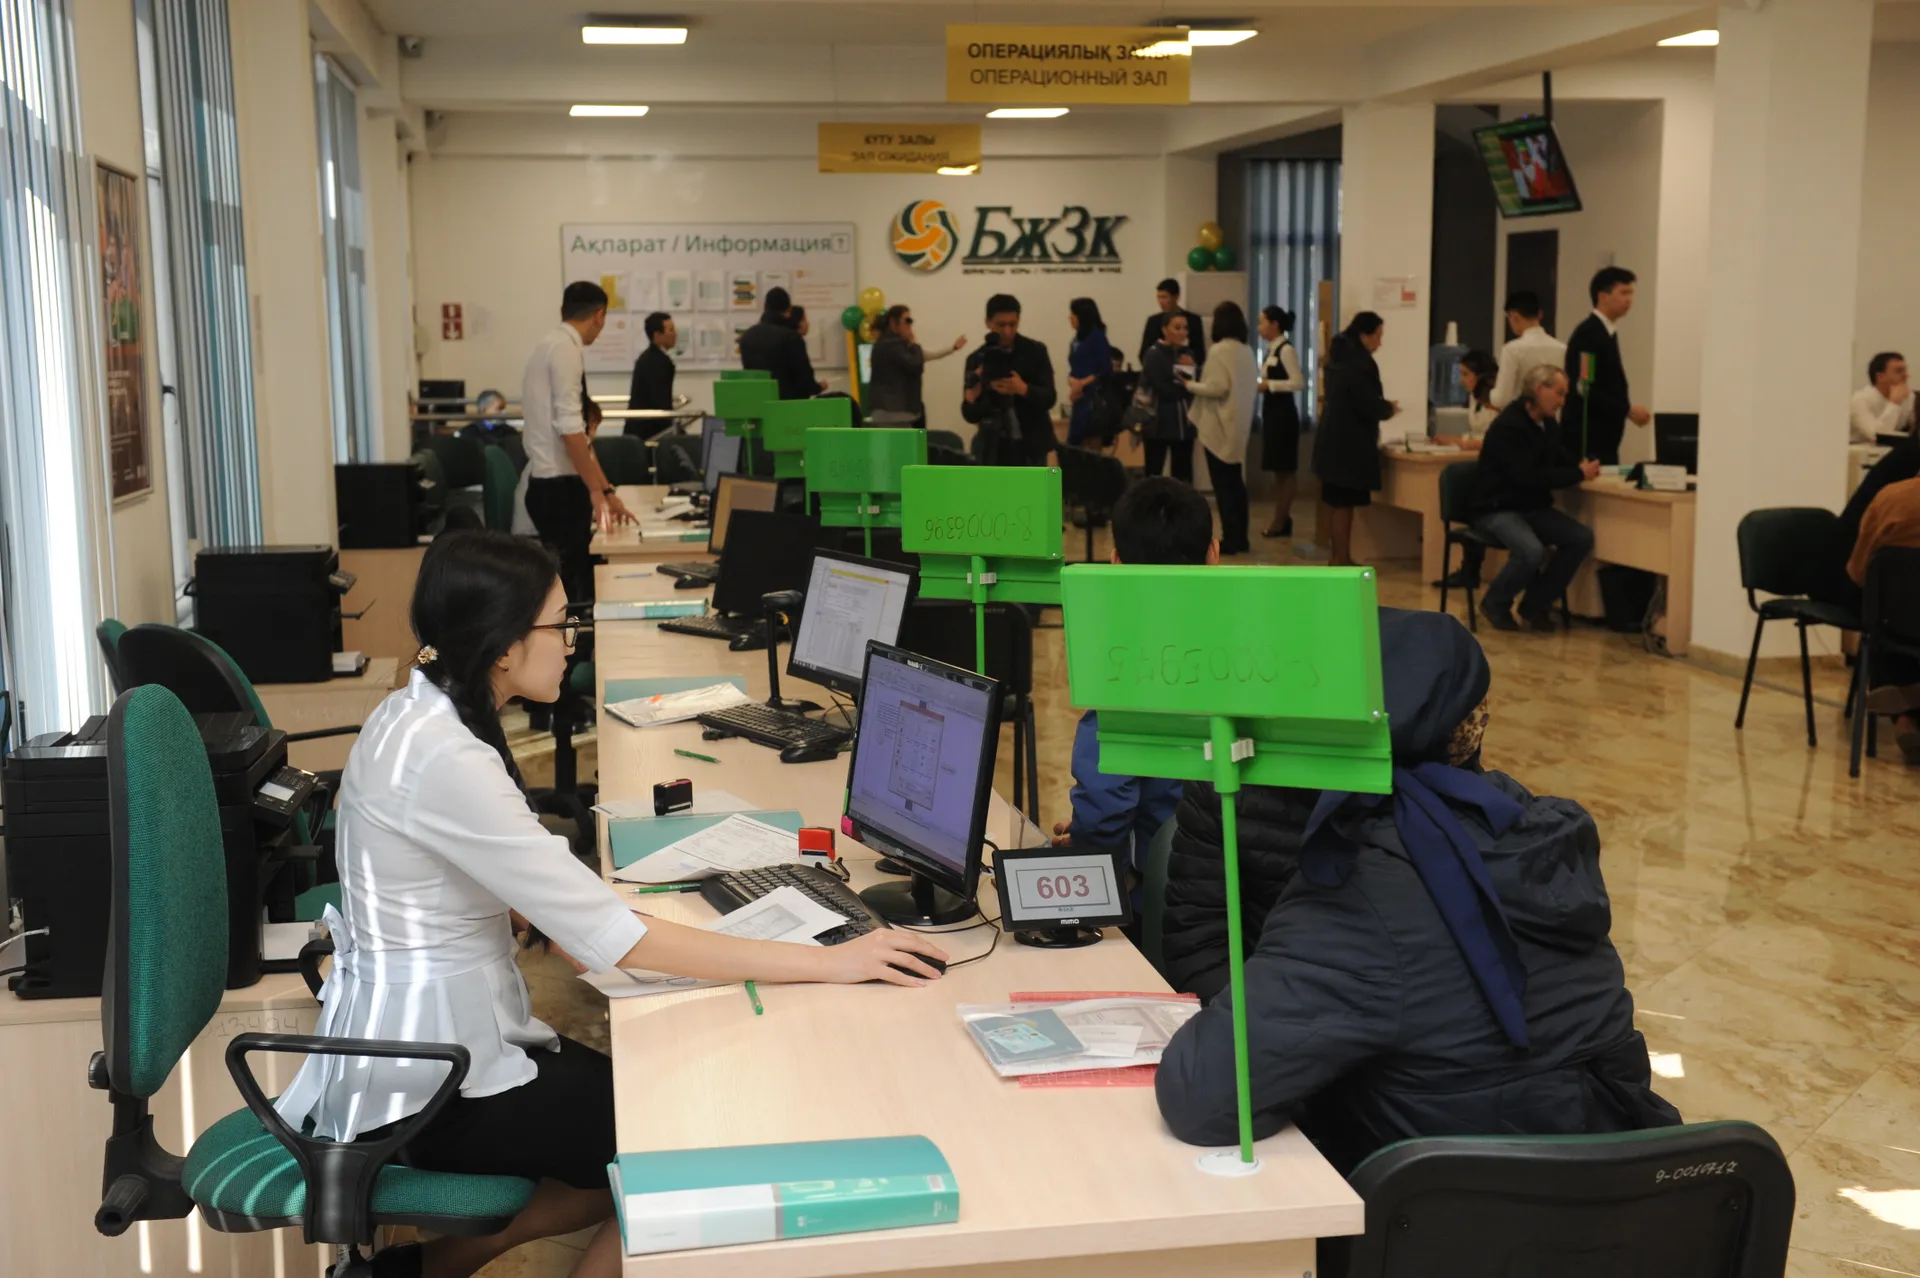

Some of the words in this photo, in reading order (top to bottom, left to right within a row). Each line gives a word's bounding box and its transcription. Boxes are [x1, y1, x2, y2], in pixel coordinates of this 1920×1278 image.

[967, 42, 1112, 61] ОПЕРАЦИЯЛЫҚ
[969, 66, 1127, 87] ОПЕРАЦИОННЫЙ
[1132, 70, 1168, 86] ЗАЛ
[570, 235, 667, 257] Ақпарат
[685, 235, 832, 257] Информация
[1036, 874, 1090, 899] 603
